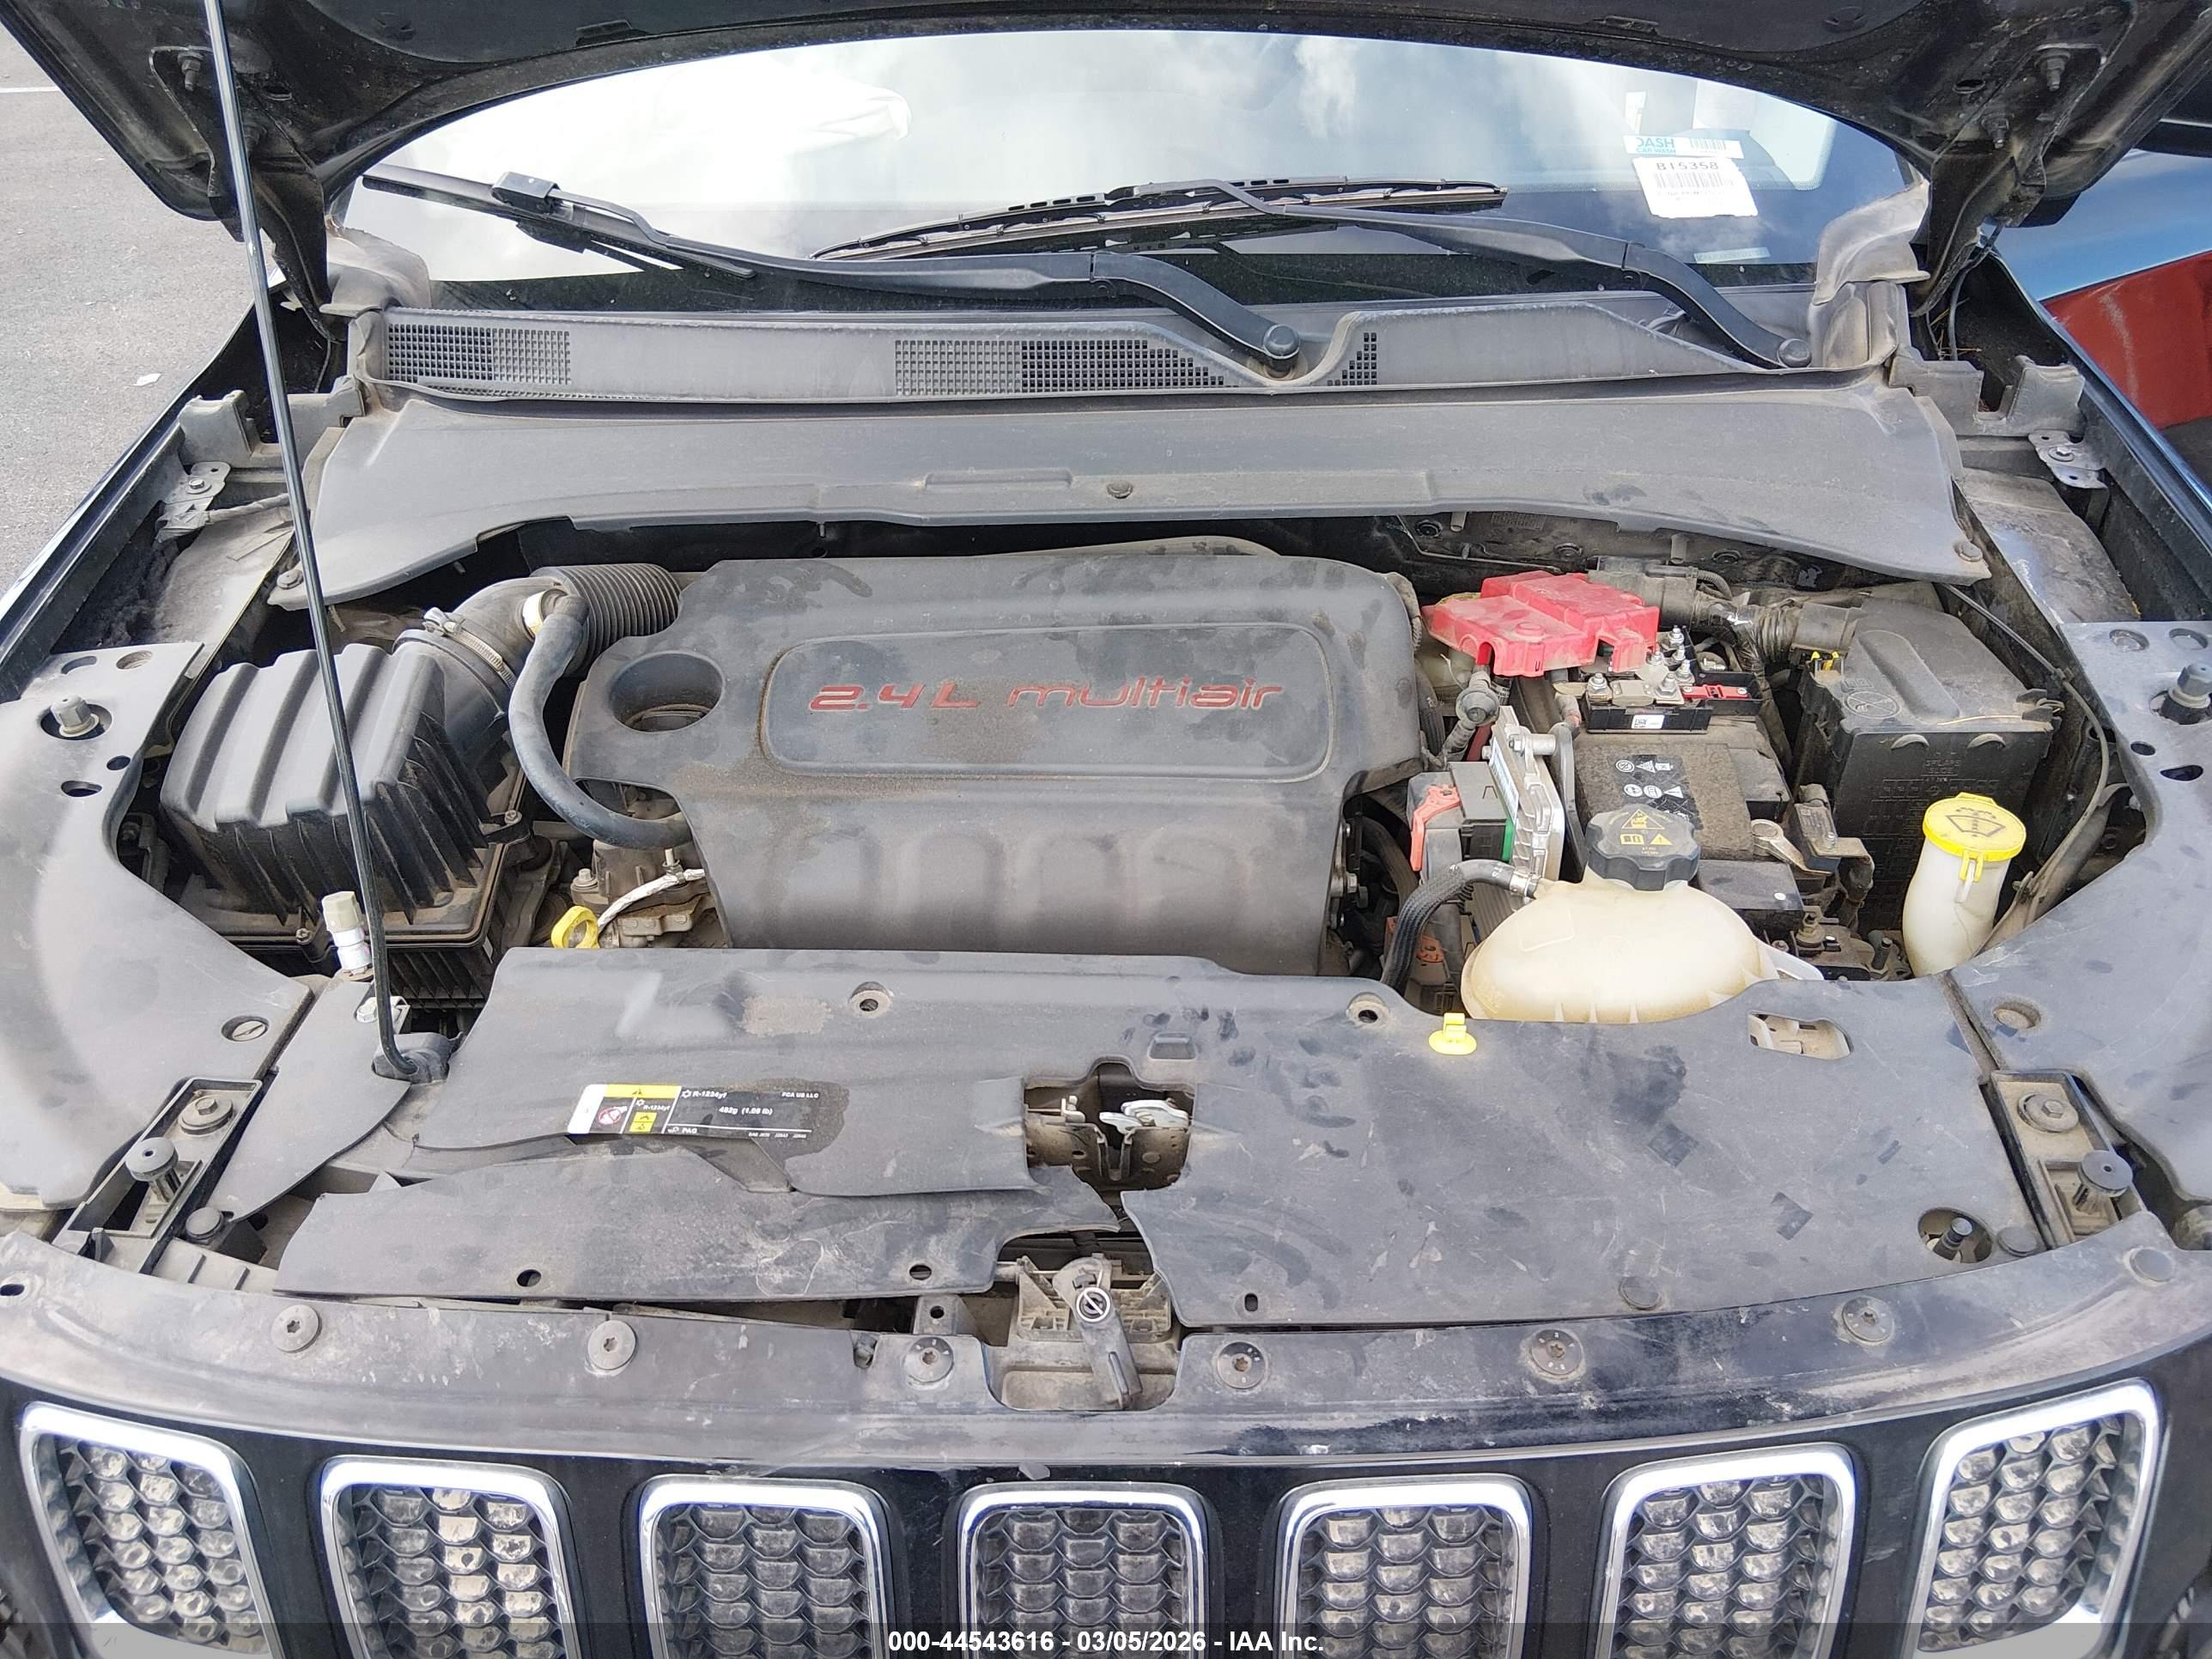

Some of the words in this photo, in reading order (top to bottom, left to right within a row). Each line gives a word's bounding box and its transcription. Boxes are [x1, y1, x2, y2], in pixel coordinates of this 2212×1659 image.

[1656, 161, 1718, 171] B15358
[1008, 674, 1285, 709] multiair
[692, 1090, 727, 1099] R-1234yf
